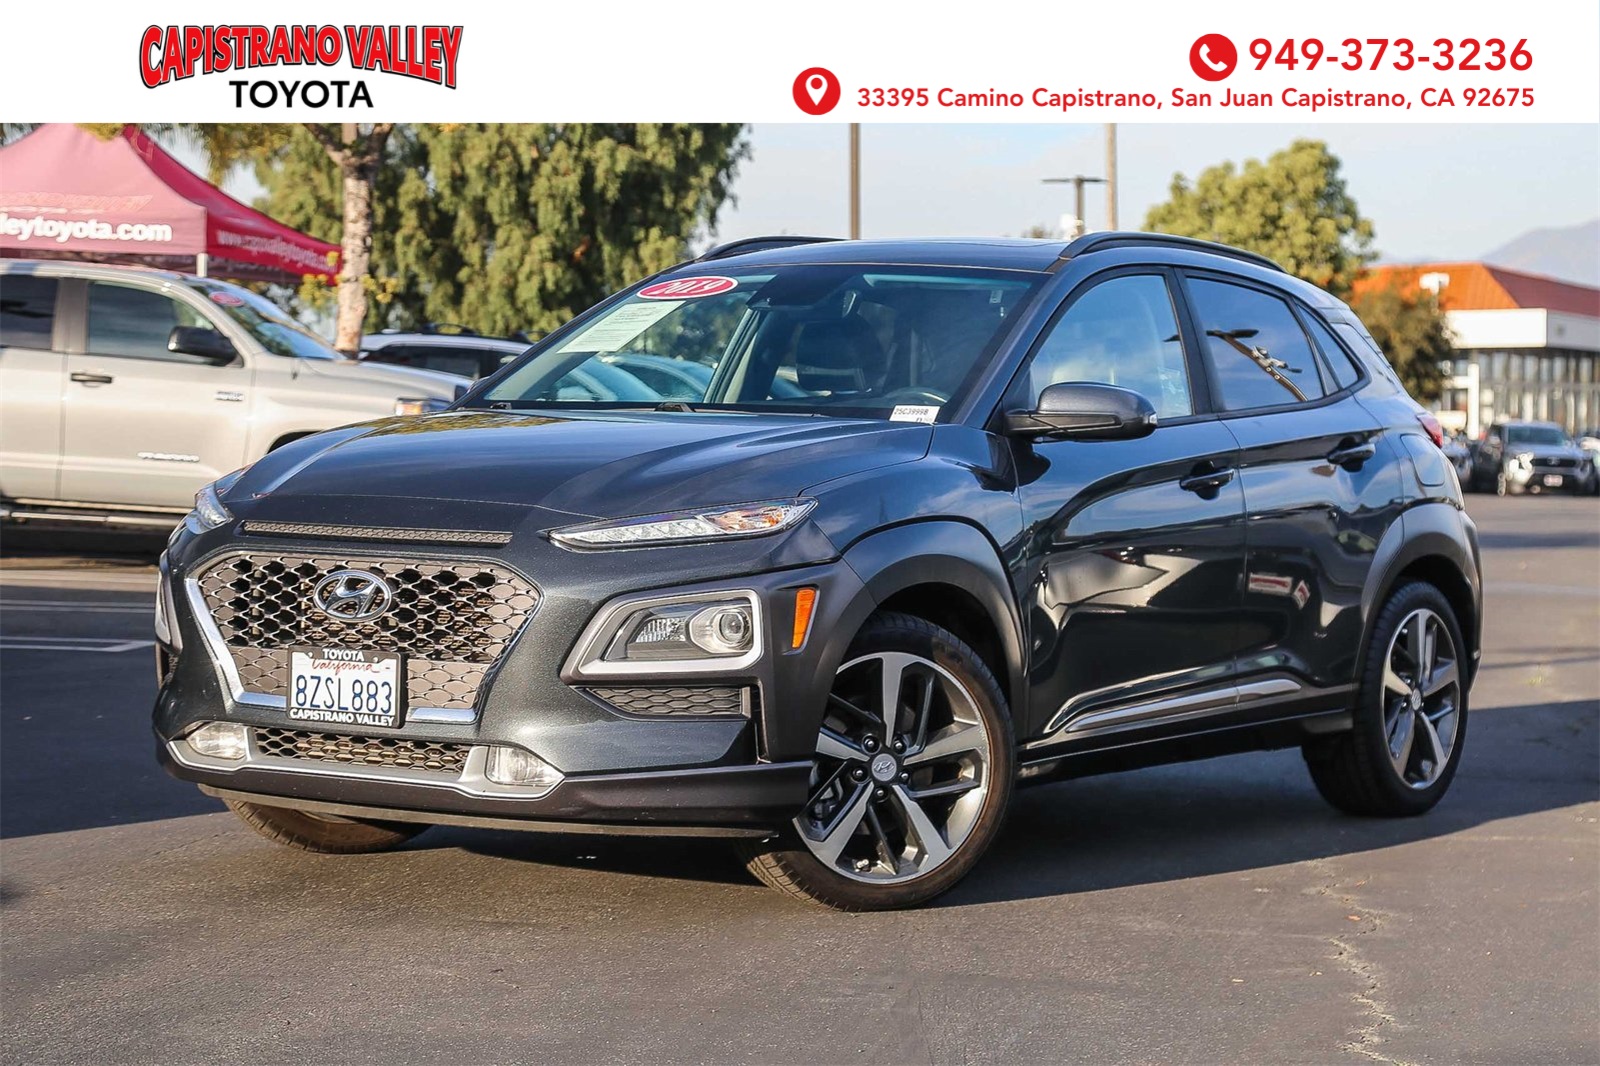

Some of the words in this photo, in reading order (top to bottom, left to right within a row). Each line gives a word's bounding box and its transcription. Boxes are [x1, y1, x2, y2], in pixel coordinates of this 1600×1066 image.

[646, 280, 728, 296] 2019
[322, 648, 365, 662] TOYOTA
[311, 658, 380, 676] California
[295, 674, 393, 715] 8ZSL883
[289, 707, 355, 724] CAPISTRANO
[355, 713, 395, 727] VALLEY
